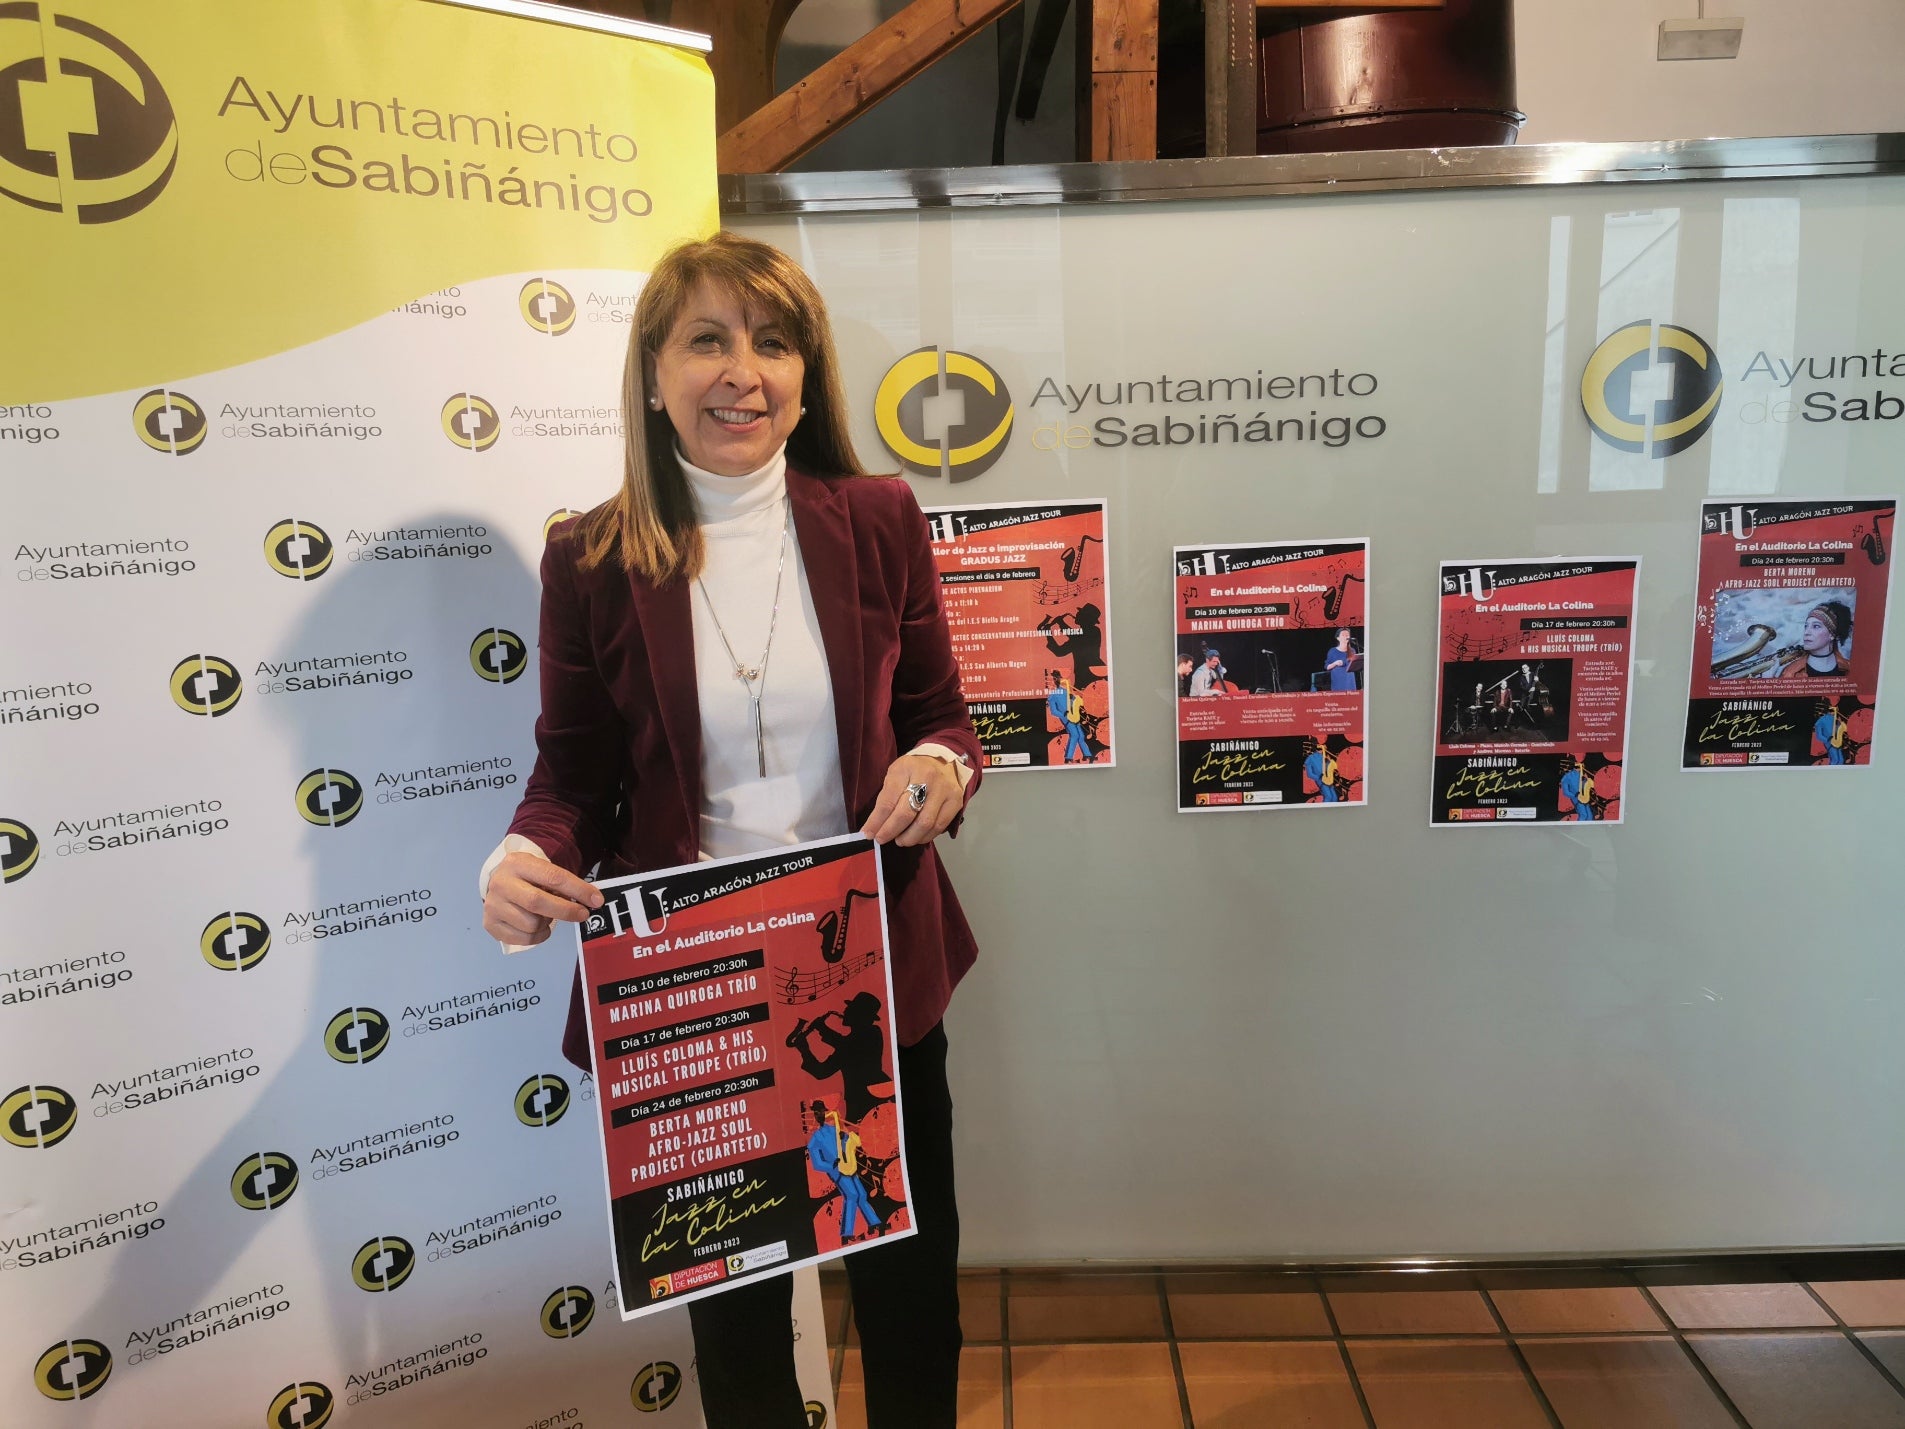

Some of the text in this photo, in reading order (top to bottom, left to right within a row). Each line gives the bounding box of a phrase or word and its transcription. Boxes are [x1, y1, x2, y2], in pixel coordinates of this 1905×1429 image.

[218, 76, 637, 163] Ayuntamiento
[225, 139, 653, 223] deSabiñánigo
[1030, 368, 1378, 413] Ayuntamiento
[219, 402, 376, 421] Ayuntamiento
[345, 524, 487, 545] Ayuntamiento
[969, 510, 1061, 532] ALTO ARAGÓN JAZZ TOUR
[15, 539, 189, 562] Ayuntamiento
[961, 554, 1026, 566] GRADUS JAZZ
[1232, 549, 1323, 571] ALTO ARAGÓN JAZZ TOUR
[1735, 541, 1853, 551] En el Auditorio La Colina
[1210, 583, 1327, 597] En el Auditorio La Colina
[1498, 566, 1593, 586] ALTO ARAGÓN JAZZ TOUR
[1764, 568, 1816, 577] BERTA MORENO
[1191, 616, 1284, 631] MARINA QUIROGA TRÍO
[1475, 601, 1594, 613] En el Auditorio La Colina
[1546, 633, 1595, 643] LLUÍS COLOMA
[254, 650, 407, 678] Ayuntamiento
[1722, 699, 1773, 711] SABIÑÁNIGO
[1210, 740, 1260, 752] SABIÑÁNIGO
[1467, 756, 1517, 768] SABIÑÁNIGO
[374, 755, 512, 787] Ayuntamiento
[54, 800, 222, 838] Ayuntamiento
[672, 856, 813, 911] ALTO ARAGÓN JAZZ TOUR
[283, 888, 432, 927] Ayuntamiento
[632, 910, 815, 959] En el Auditorio La Colina
[618, 957, 748, 997] Día 10 de febrero 20:30h
[401, 979, 536, 1021] Ayuntamiento
[609, 974, 757, 1024] MARINA QUIROGA TRÍO
[621, 1010, 750, 1050] Día 17 de febrero 20:30h
[611, 1072, 668, 1099] MUSICAL
[673, 1057, 721, 1082] TROUPE
[726, 1045, 768, 1070] (TRÍO)
[621, 1030, 754, 1076] LLUÍS COLOMA & HIS
[91, 1048, 254, 1100] Ayuntamiento
[631, 1077, 759, 1119] Día 24 de febrero 20:30h
[648, 1118, 753, 1158] AFRO-JAZZ SOUL
[650, 1099, 747, 1138] BERTA MORENO
[310, 1114, 454, 1164] Ayuntamiento
[631, 1131, 768, 1183] PROJECT (CUARTETO)
[667, 1168, 745, 1203] SABIÑÁNIGO
[426, 1193, 557, 1246] Ayuntamiento
[651, 1177, 767, 1236] Jazz en
[641, 1194, 787, 1263] la Colina
[693, 1236, 741, 1258] FEBRERO 2023
[675, 1271, 719, 1289] DE HUESCA
[125, 1284, 284, 1348] Ayuntamiento
[344, 1330, 482, 1390] Ayuntamiento
